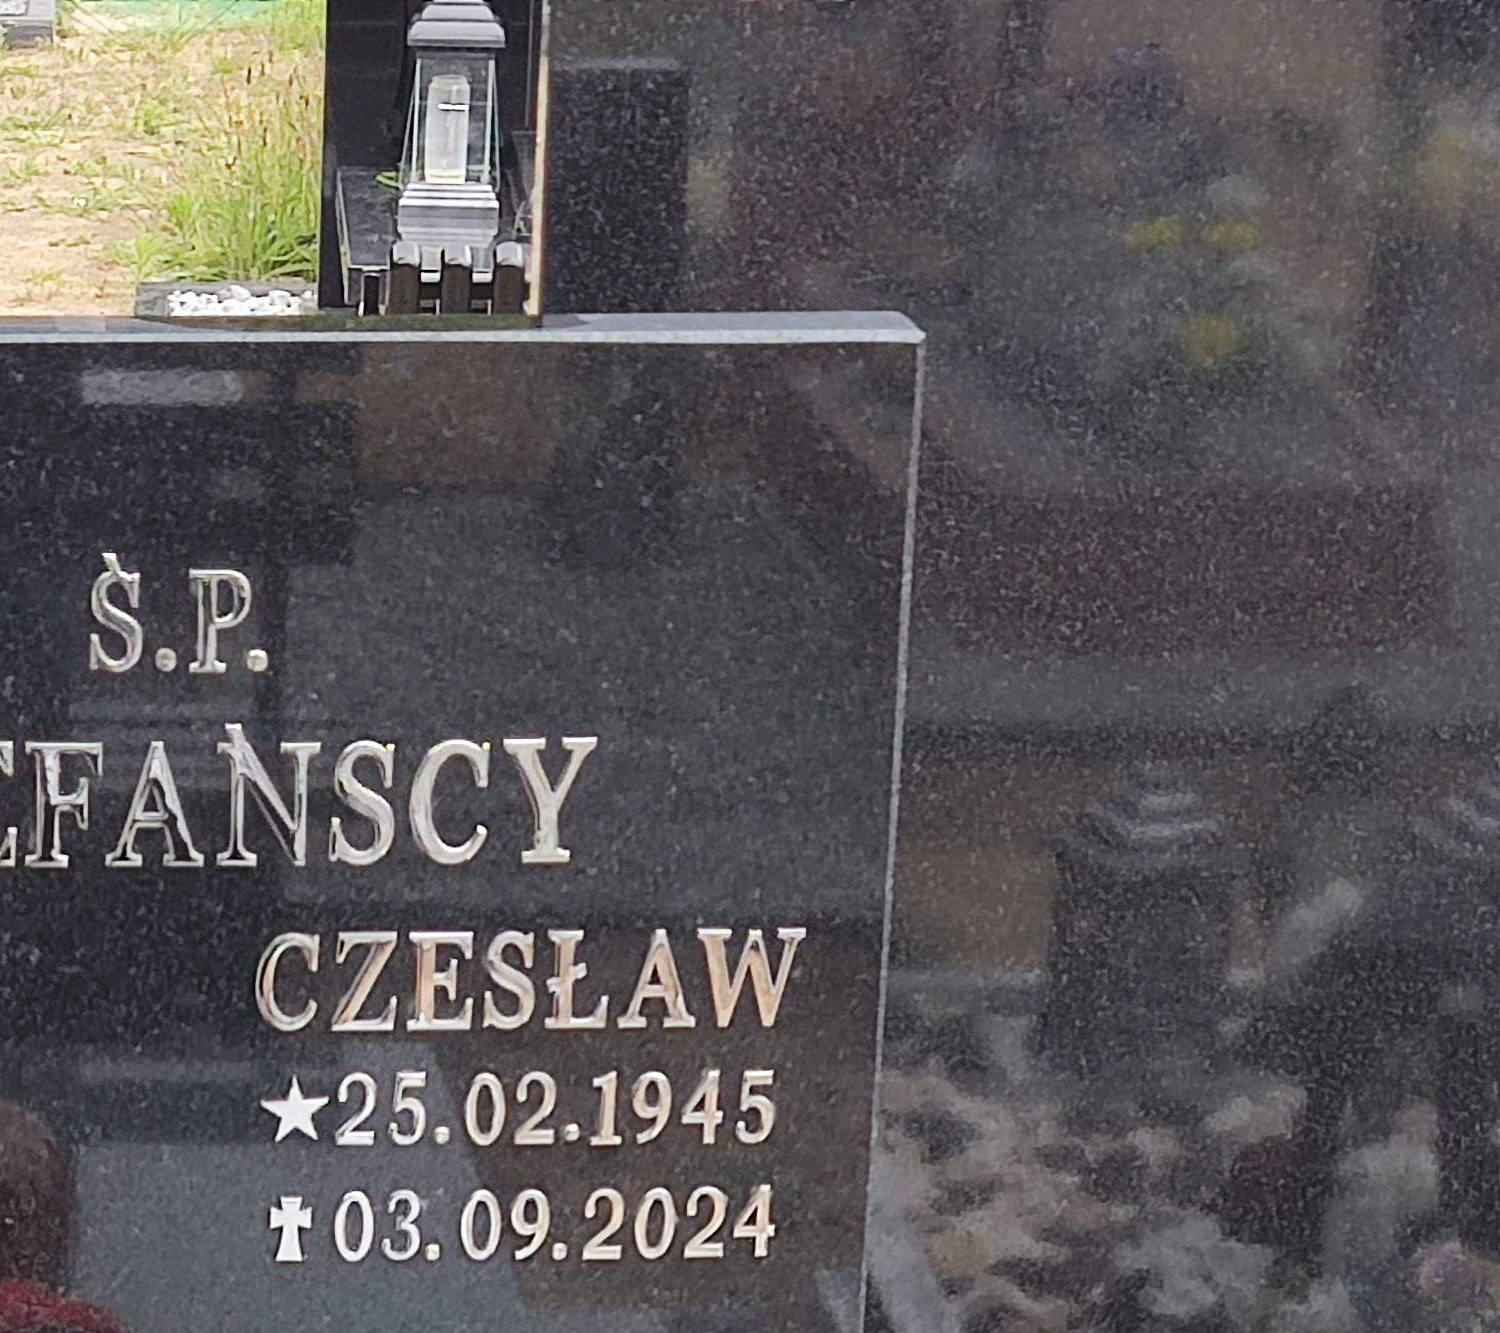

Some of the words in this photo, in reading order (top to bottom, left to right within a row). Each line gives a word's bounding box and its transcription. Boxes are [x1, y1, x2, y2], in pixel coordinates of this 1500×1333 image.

[255, 927, 808, 1032] CZESŁAW
[335, 1068, 776, 1147] 25.02.1945
[333, 1184, 775, 1260] 03.09.2024
